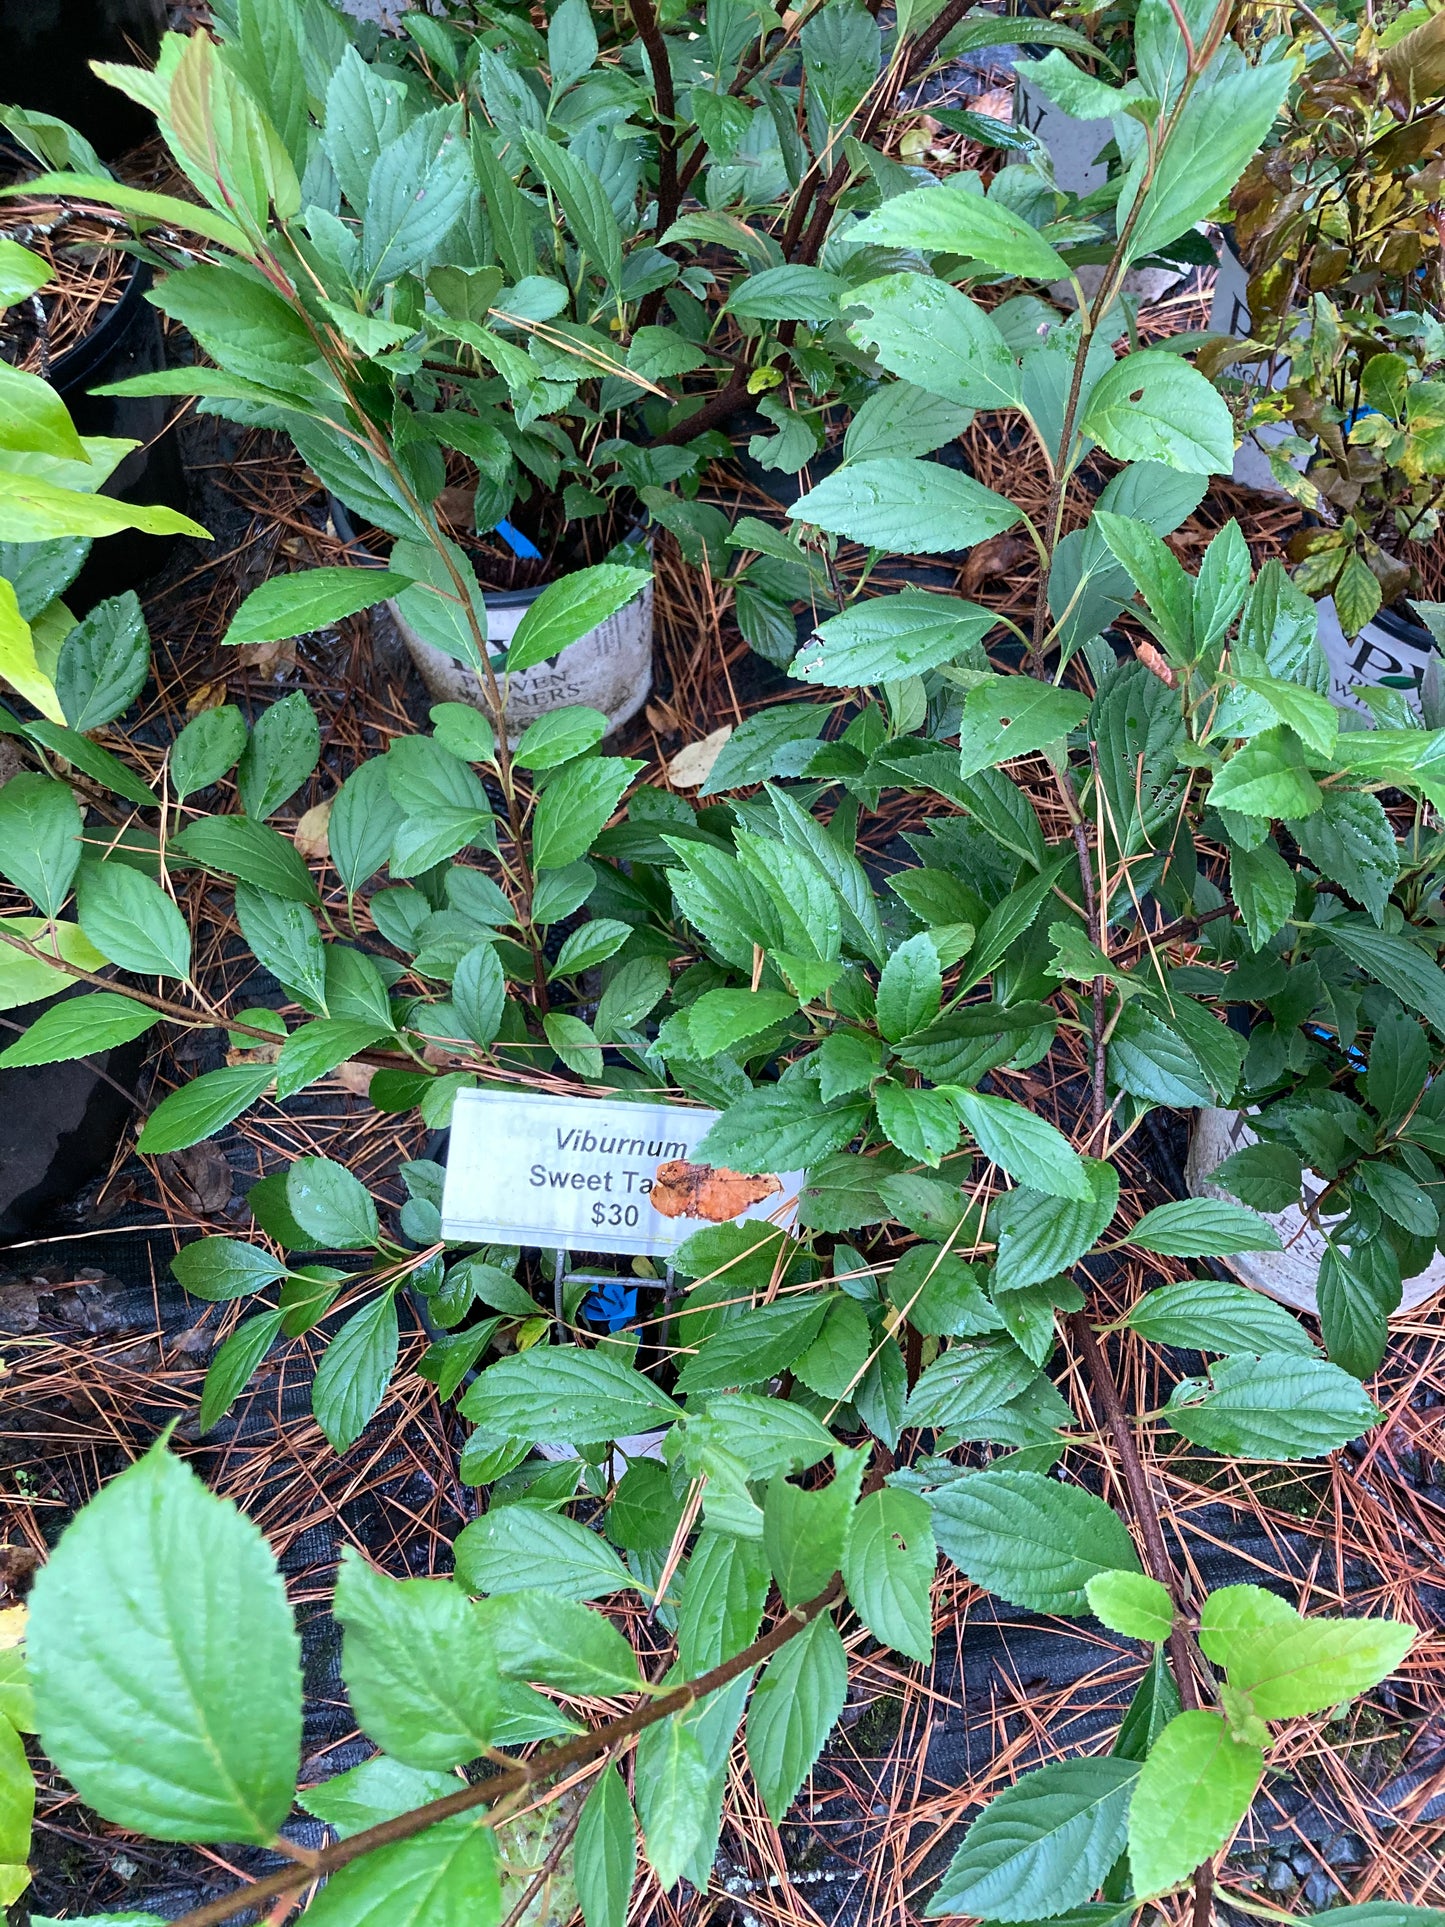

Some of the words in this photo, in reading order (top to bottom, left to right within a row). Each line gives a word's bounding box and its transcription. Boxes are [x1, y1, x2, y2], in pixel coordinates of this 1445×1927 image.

[461, 671, 568, 693] PVEN
[556, 1128, 688, 1159] Viburnum
[529, 1164, 613, 1192] Sweet
[622, 1171, 653, 1195] Ta
[591, 1202, 639, 1227] $30
